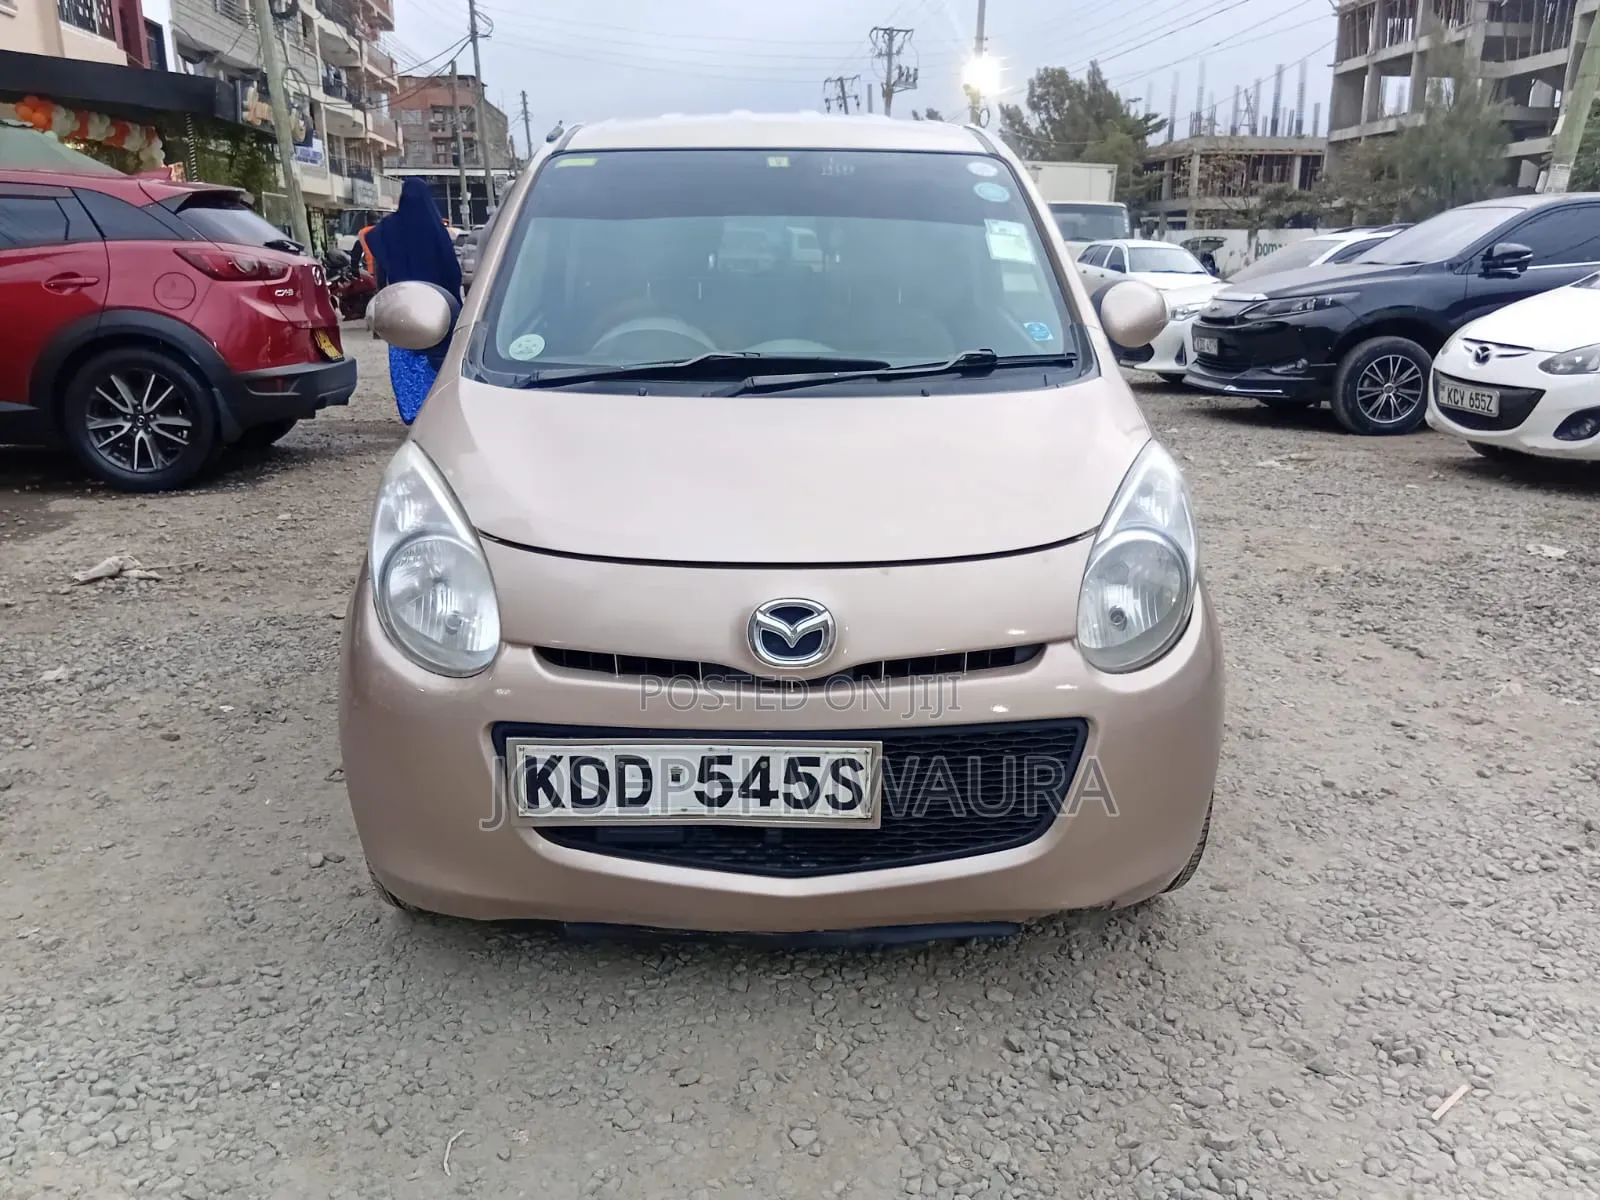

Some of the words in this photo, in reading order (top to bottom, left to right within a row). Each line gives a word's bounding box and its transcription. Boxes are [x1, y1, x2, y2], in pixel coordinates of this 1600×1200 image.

[1447, 387, 1465, 406] KCY
[1469, 391, 1493, 413] 655Z
[525, 754, 654, 809] KDD
[693, 754, 865, 812] 545S
